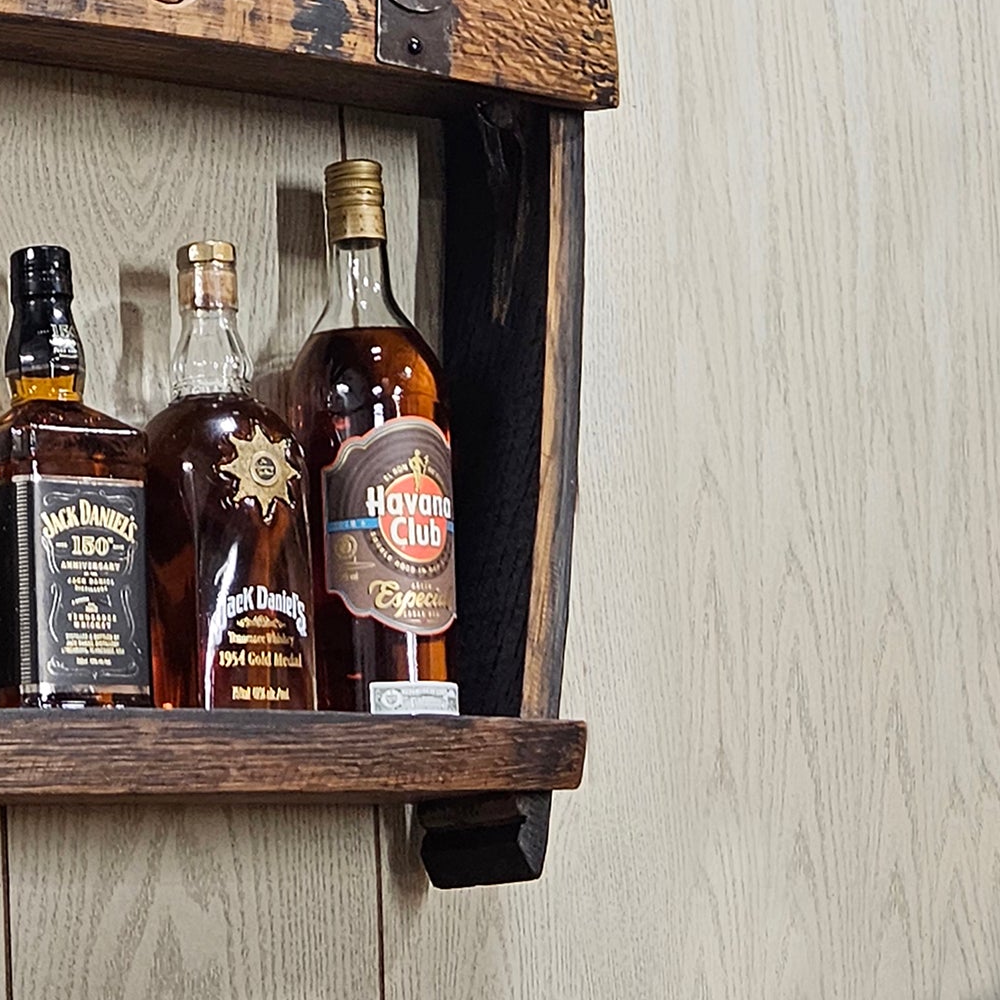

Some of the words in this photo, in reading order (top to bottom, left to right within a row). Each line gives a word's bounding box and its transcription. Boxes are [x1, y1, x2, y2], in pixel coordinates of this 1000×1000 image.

[365, 484, 452, 519] Havana
[41, 505, 79, 540] JACK
[79, 498, 138, 545] DANIEL'S
[391, 516, 442, 547] Club
[256, 585, 308, 637] Daniel's
[368, 579, 449, 618] Especia
[219, 648, 246, 667] 1954
[247, 650, 272, 667] Gold
[273, 652, 303, 668] Medal
